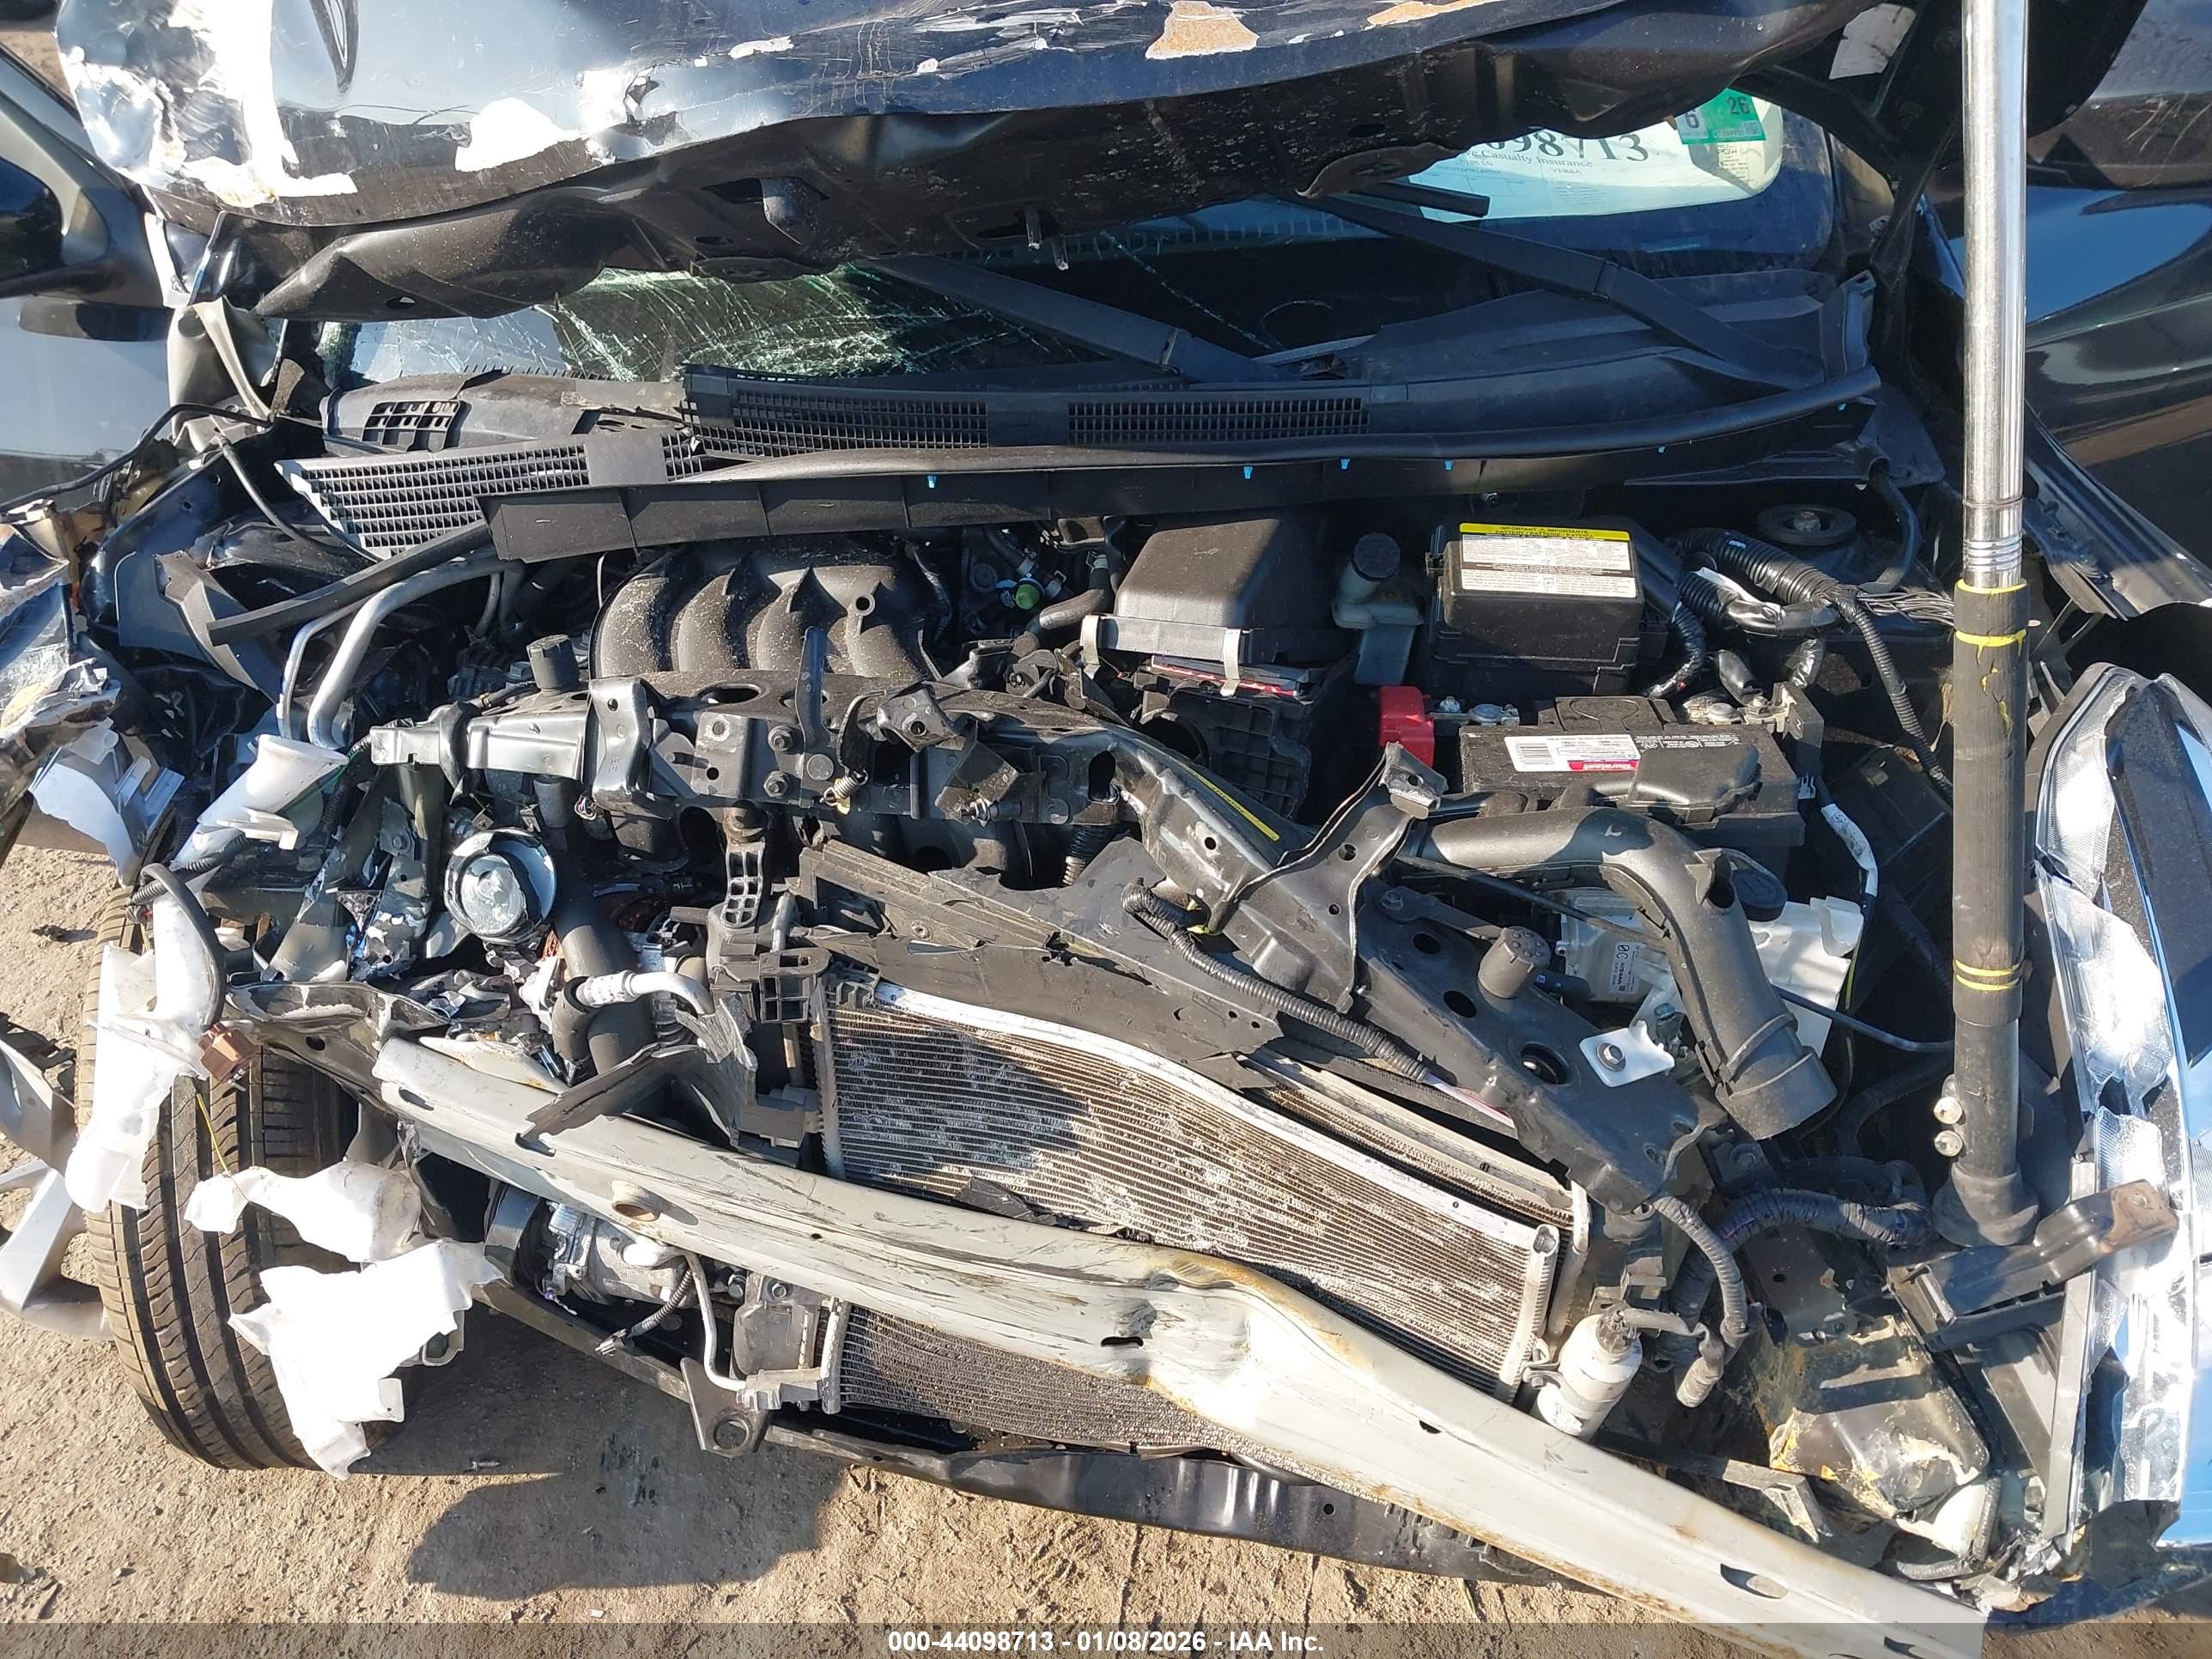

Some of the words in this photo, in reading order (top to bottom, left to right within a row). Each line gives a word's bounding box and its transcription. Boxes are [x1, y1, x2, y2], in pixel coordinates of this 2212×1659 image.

[1727, 95, 1751, 115] 26
[1481, 149, 1532, 164] Casualty
[1536, 156, 1593, 167] Insurance
